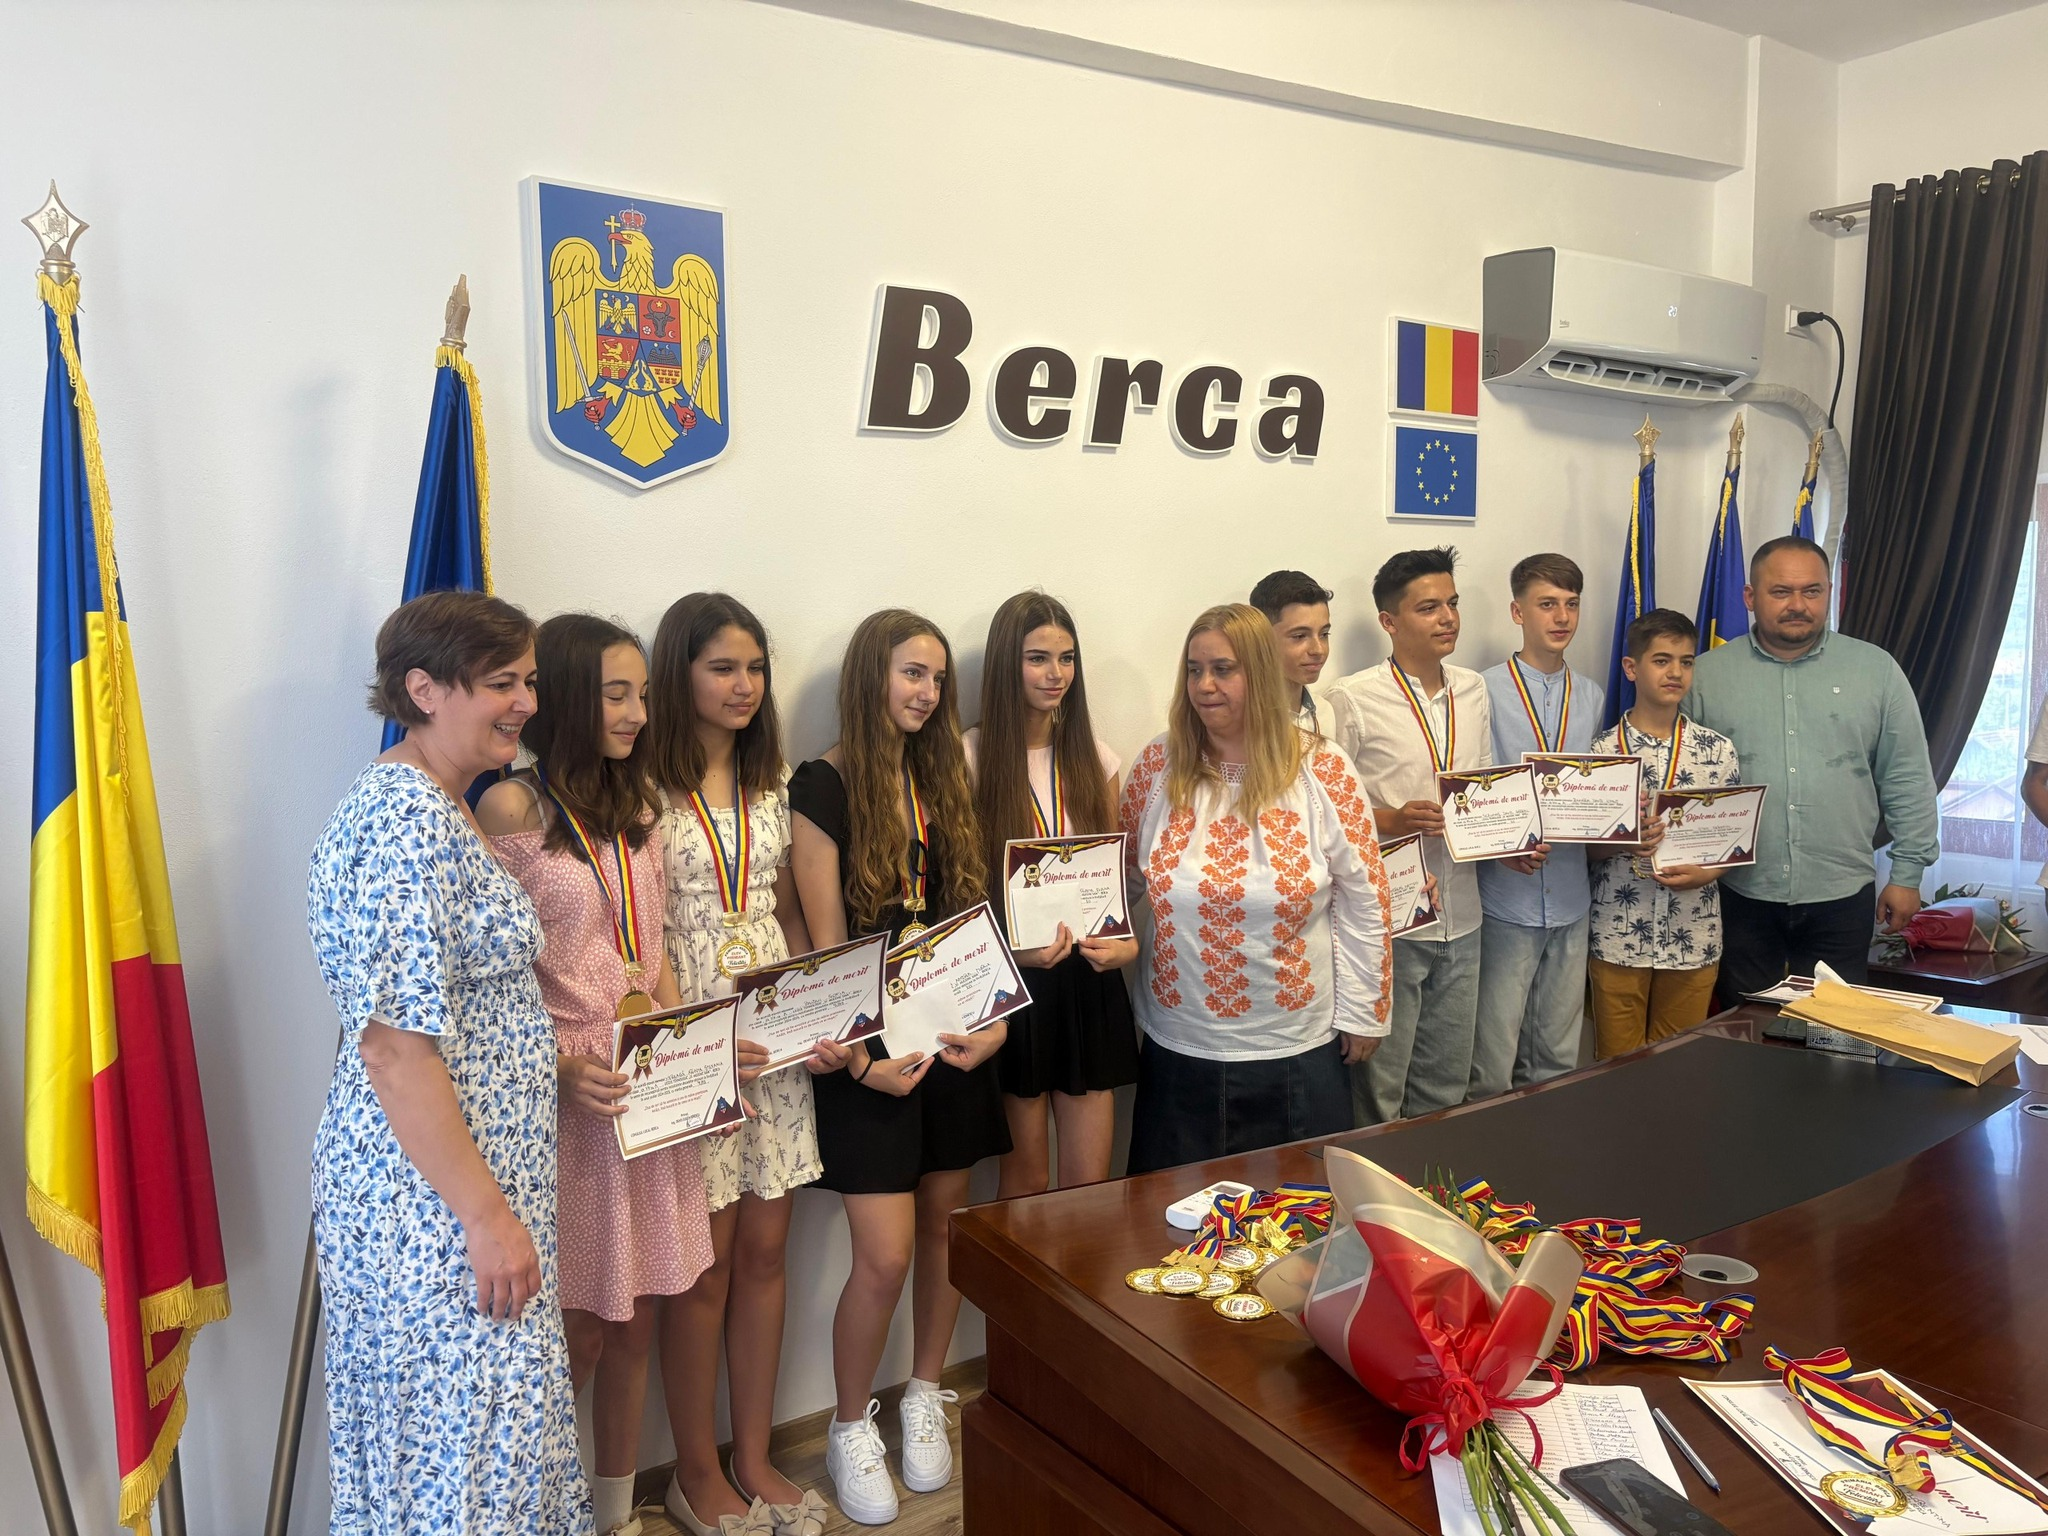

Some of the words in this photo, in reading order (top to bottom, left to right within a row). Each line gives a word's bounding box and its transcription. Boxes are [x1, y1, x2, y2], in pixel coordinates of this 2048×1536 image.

[863, 284, 1326, 462] Berca
[1562, 782, 1596, 792] Diplomă
[1470, 797, 1499, 809] Diplomă
[1511, 793, 1529, 802] merit
[1685, 813, 1716, 822] Diplomă
[1718, 811, 1727, 819] de
[1728, 809, 1749, 817] merit
[1043, 871, 1077, 884] Diplomă
[1079, 869, 1089, 879] de
[1090, 868, 1112, 878] merit
[1390, 871, 1398, 880] de
[1399, 865, 1416, 877] merit
[909, 963, 948, 991] Diplomă
[950, 957, 961, 968] de
[964, 942, 988, 961] merit
[781, 980, 825, 1001] Diplomă
[828, 975, 840, 985] de
[842, 965, 870, 981] merit
[654, 1047, 690, 1068] Diplomă
[692, 1044, 702, 1055] de
[703, 1037, 726, 1052] merit
[1843, 1484, 1884, 1499] PREMIANT
[1855, 1483, 1876, 1493] ELEV
[1934, 1488, 1988, 1522] merit
